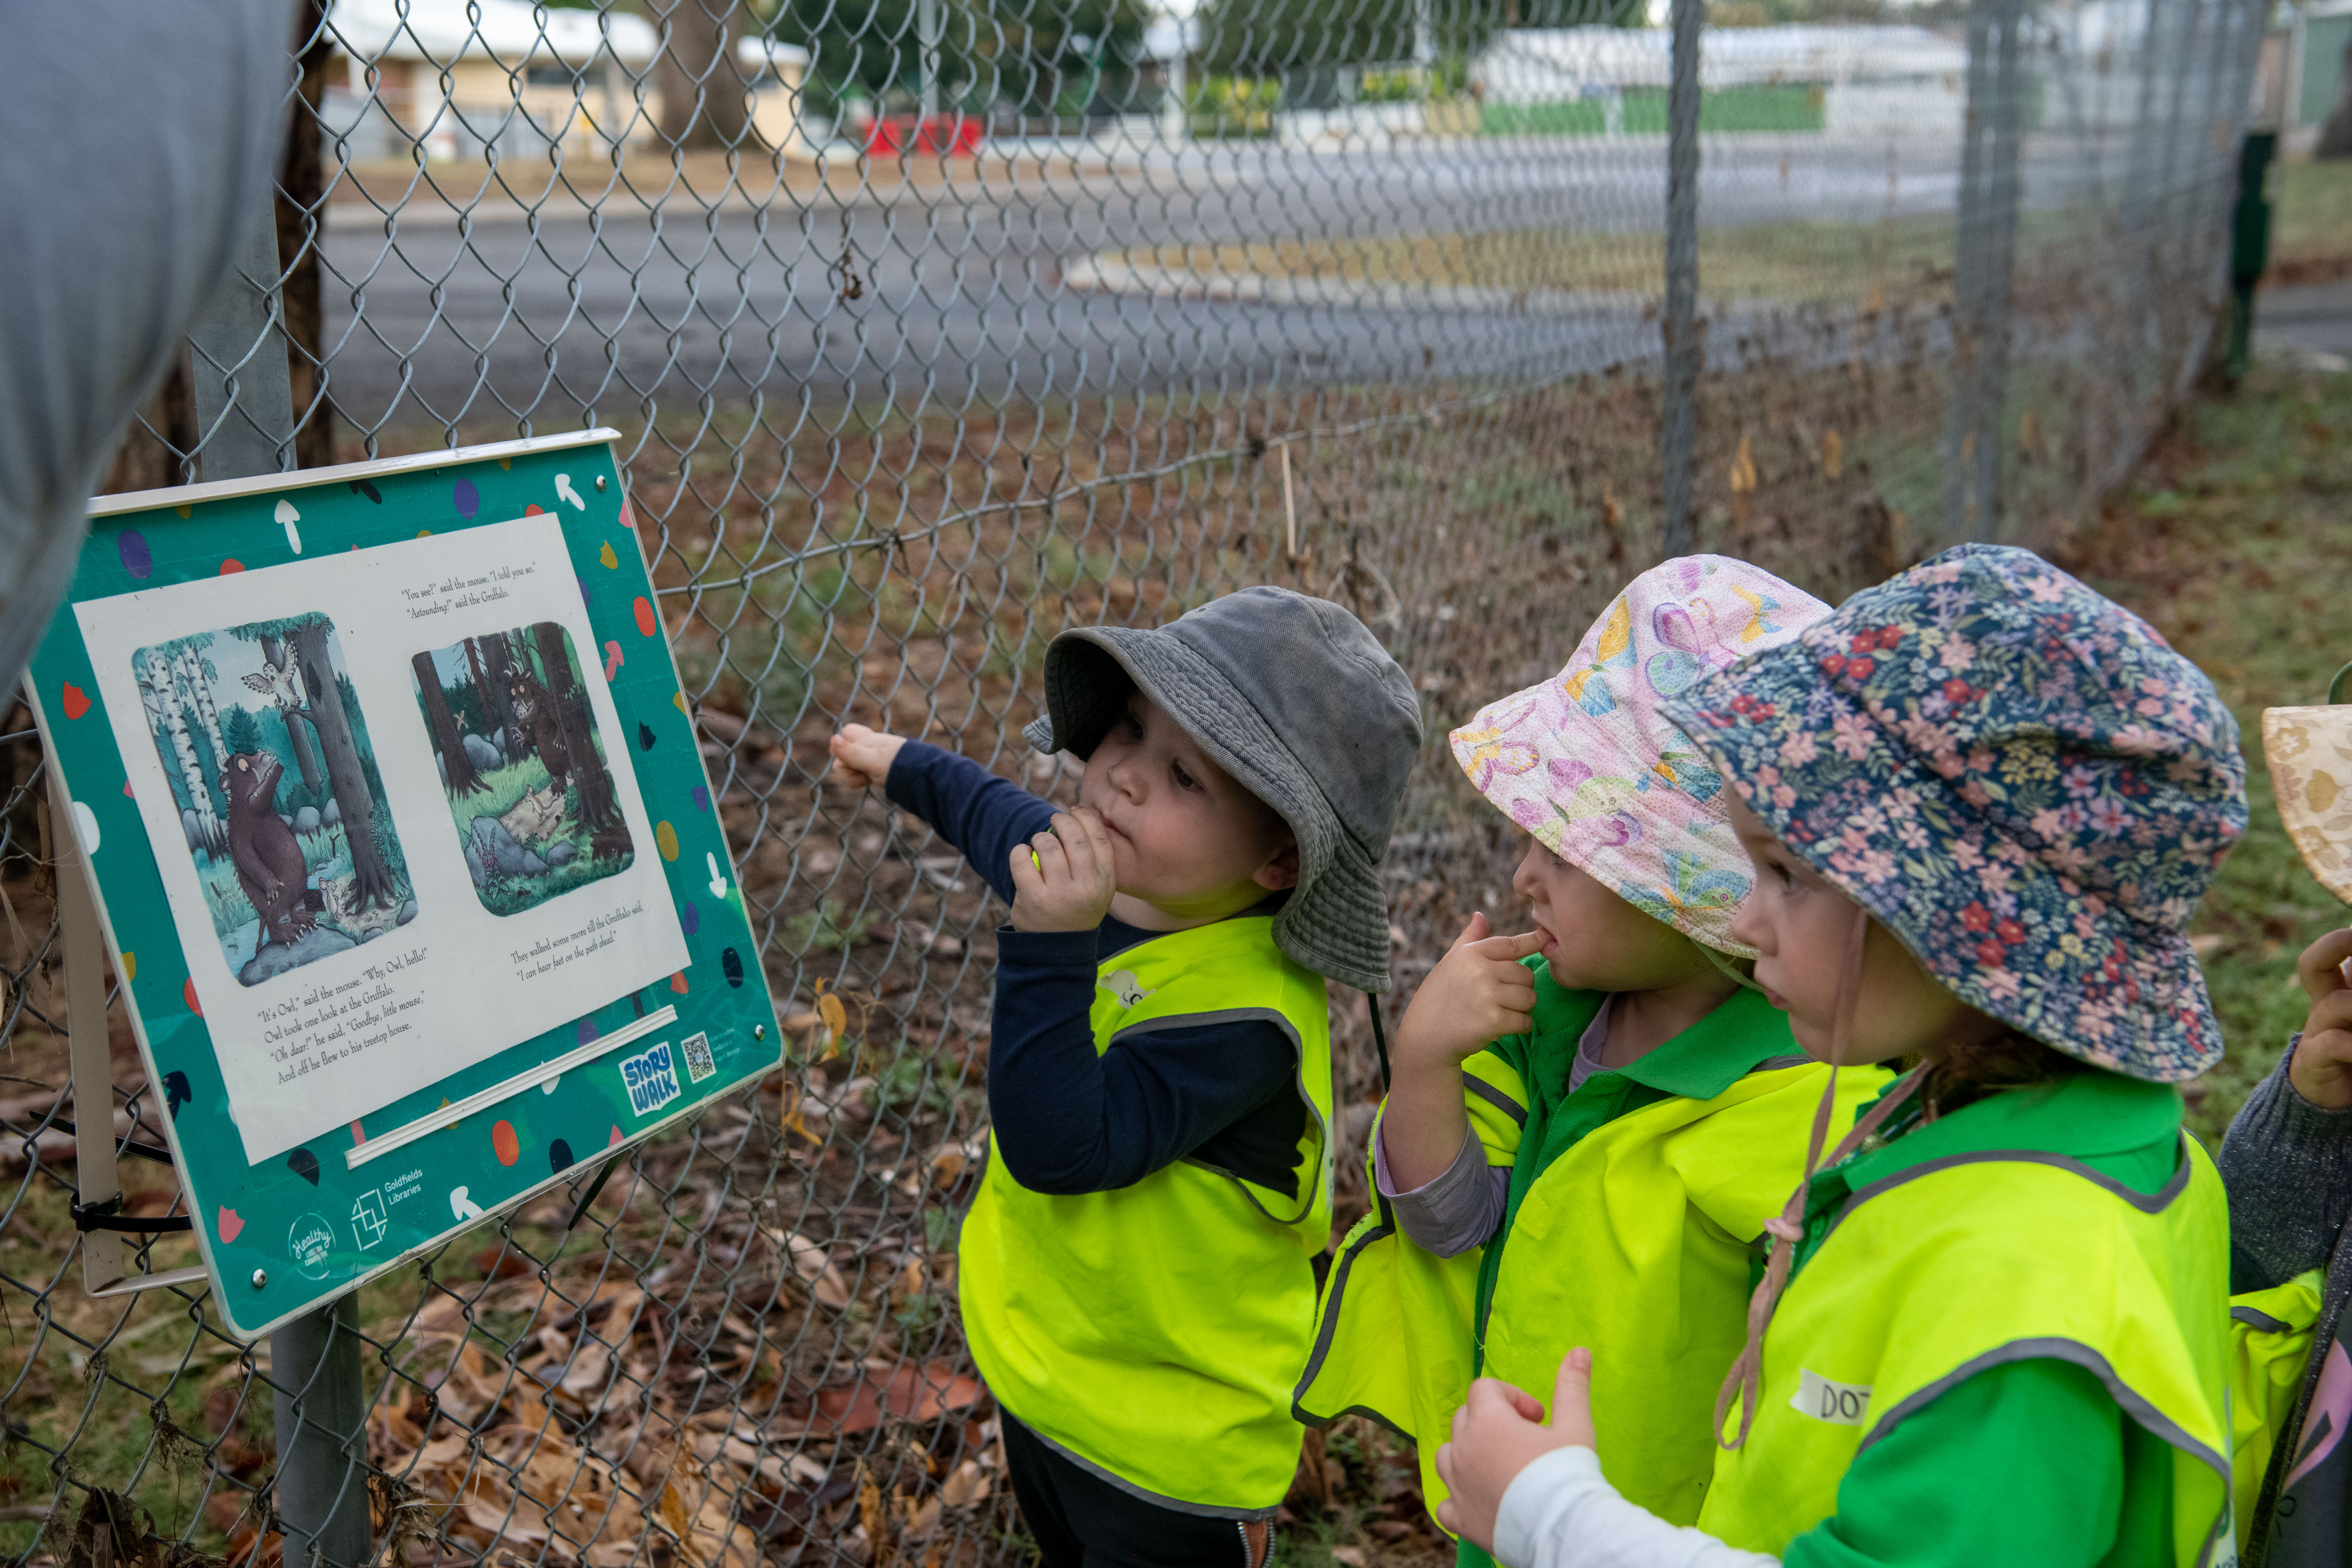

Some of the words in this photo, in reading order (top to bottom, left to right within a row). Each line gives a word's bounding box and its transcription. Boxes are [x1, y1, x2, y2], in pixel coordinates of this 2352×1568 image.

[401, 589, 420, 600] “You
[420, 583, 436, 597] see?”
[440, 578, 454, 593] said
[454, 577, 466, 589] the
[467, 577, 489, 586] mouse.
[490, 571, 497, 581] “I
[498, 566, 511, 580] told
[512, 569, 524, 579] you
[525, 562, 535, 574] so.”
[407, 599, 451, 619] “Astounding!”
[455, 594, 468, 609] said
[469, 593, 481, 605] the
[481, 586, 509, 602] Gruffalo.
[510, 950, 528, 964] They
[529, 937, 551, 957] walked
[552, 936, 569, 948] some
[570, 929, 586, 940] more
[587, 919, 596, 933] till
[596, 917, 605, 929] the
[605, 906, 631, 925] Gruffalo
[632, 900, 643, 915] said,
[517, 970, 524, 981] “I
[526, 969, 536, 979] can
[537, 961, 551, 974] hear
[553, 955, 564, 971] feet
[565, 953, 574, 962] on
[574, 945, 585, 959] the
[586, 938, 598, 956] path
[599, 930, 616, 948] ahead.”
[258, 1008, 277, 1023] “It’s
[278, 997, 299, 1015] Owl,”
[304, 989, 319, 1007] said
[320, 985, 334, 999] the
[335, 980, 362, 994] mouse.
[362, 965, 385, 980] “Why,
[386, 956, 404, 973] Owl,
[404, 947, 427, 966] hello!”
[265, 1025, 283, 1043] Owl
[284, 1018, 303, 1036] took
[304, 1017, 319, 1028] one
[320, 1004, 338, 1023] look
[340, 1005, 348, 1014] at
[349, 996, 362, 1010] the
[363, 983, 395, 1004] Gruffalo.
[270, 1046, 288, 1062] “Oh
[291, 1037, 311, 1056] dear!”
[313, 1033, 326, 1046] he
[327, 1023, 346, 1042] said,
[346, 1011, 382, 1031] “Goodbye,
[382, 1001, 397, 1018] little
[399, 990, 424, 1011] mouse,”
[278, 1065, 296, 1084] And
[298, 1059, 310, 1075] off
[308, 1057, 321, 1070] he
[321, 1051, 338, 1065] flew
[339, 1049, 349, 1057] to
[348, 1040, 362, 1053] his
[363, 1033, 387, 1048] treetop
[387, 1023, 412, 1037] house.
[624, 1046, 671, 1087] STORY
[632, 1071, 678, 1111] WALK
[384, 1168, 423, 1192] Goldfields
[388, 1184, 421, 1205] Libraries
[292, 1228, 331, 1260] Healthy
